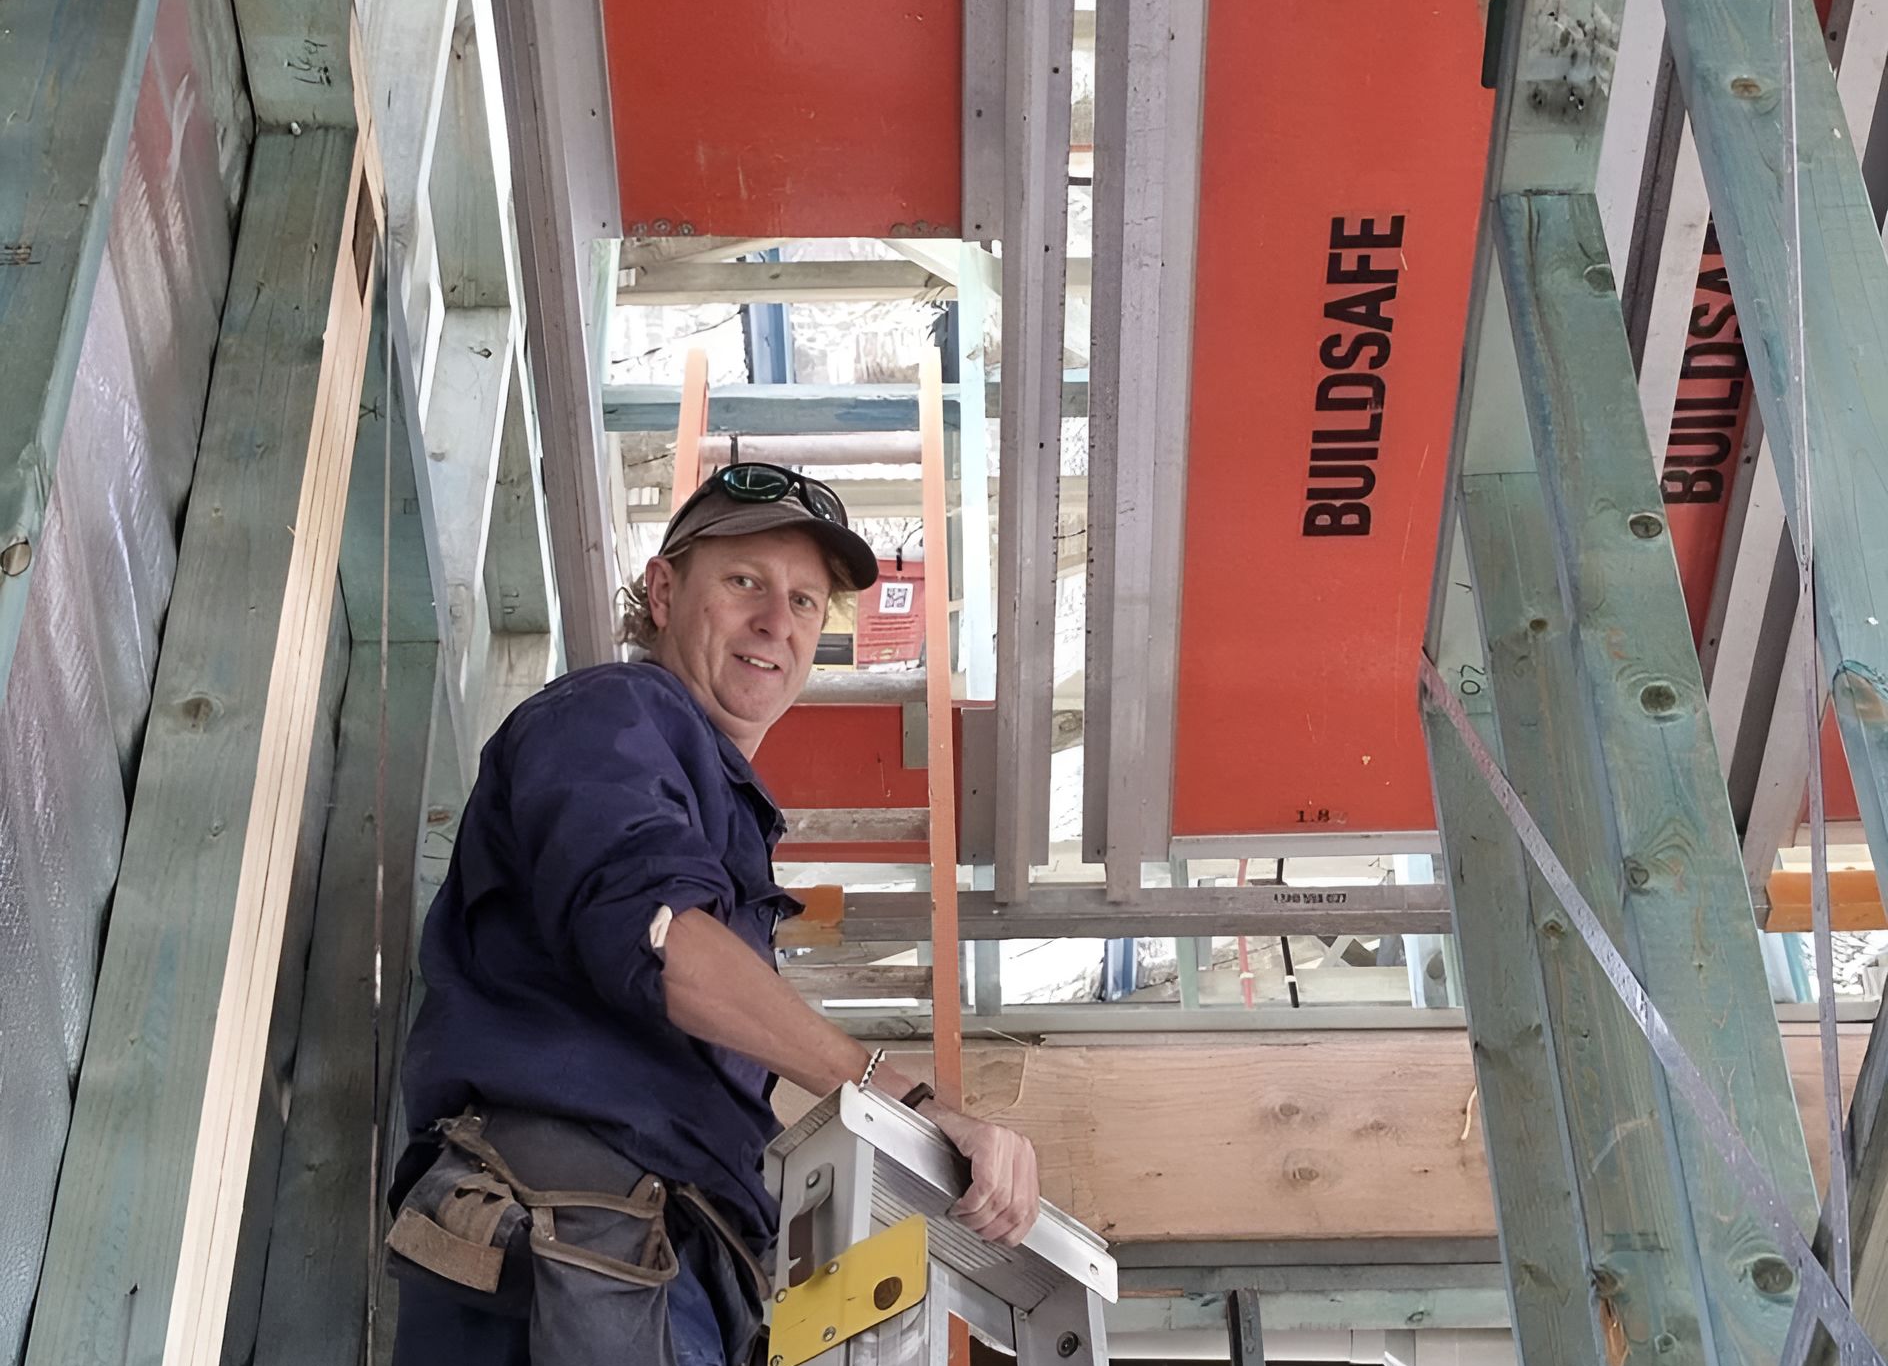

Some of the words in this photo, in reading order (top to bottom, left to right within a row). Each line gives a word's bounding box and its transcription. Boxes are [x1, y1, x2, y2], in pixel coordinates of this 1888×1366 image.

[1302, 214, 1405, 536] BUILDSAFE
[1662, 211, 1749, 504] BUILDS
[1296, 809, 1330, 823] 1.8
